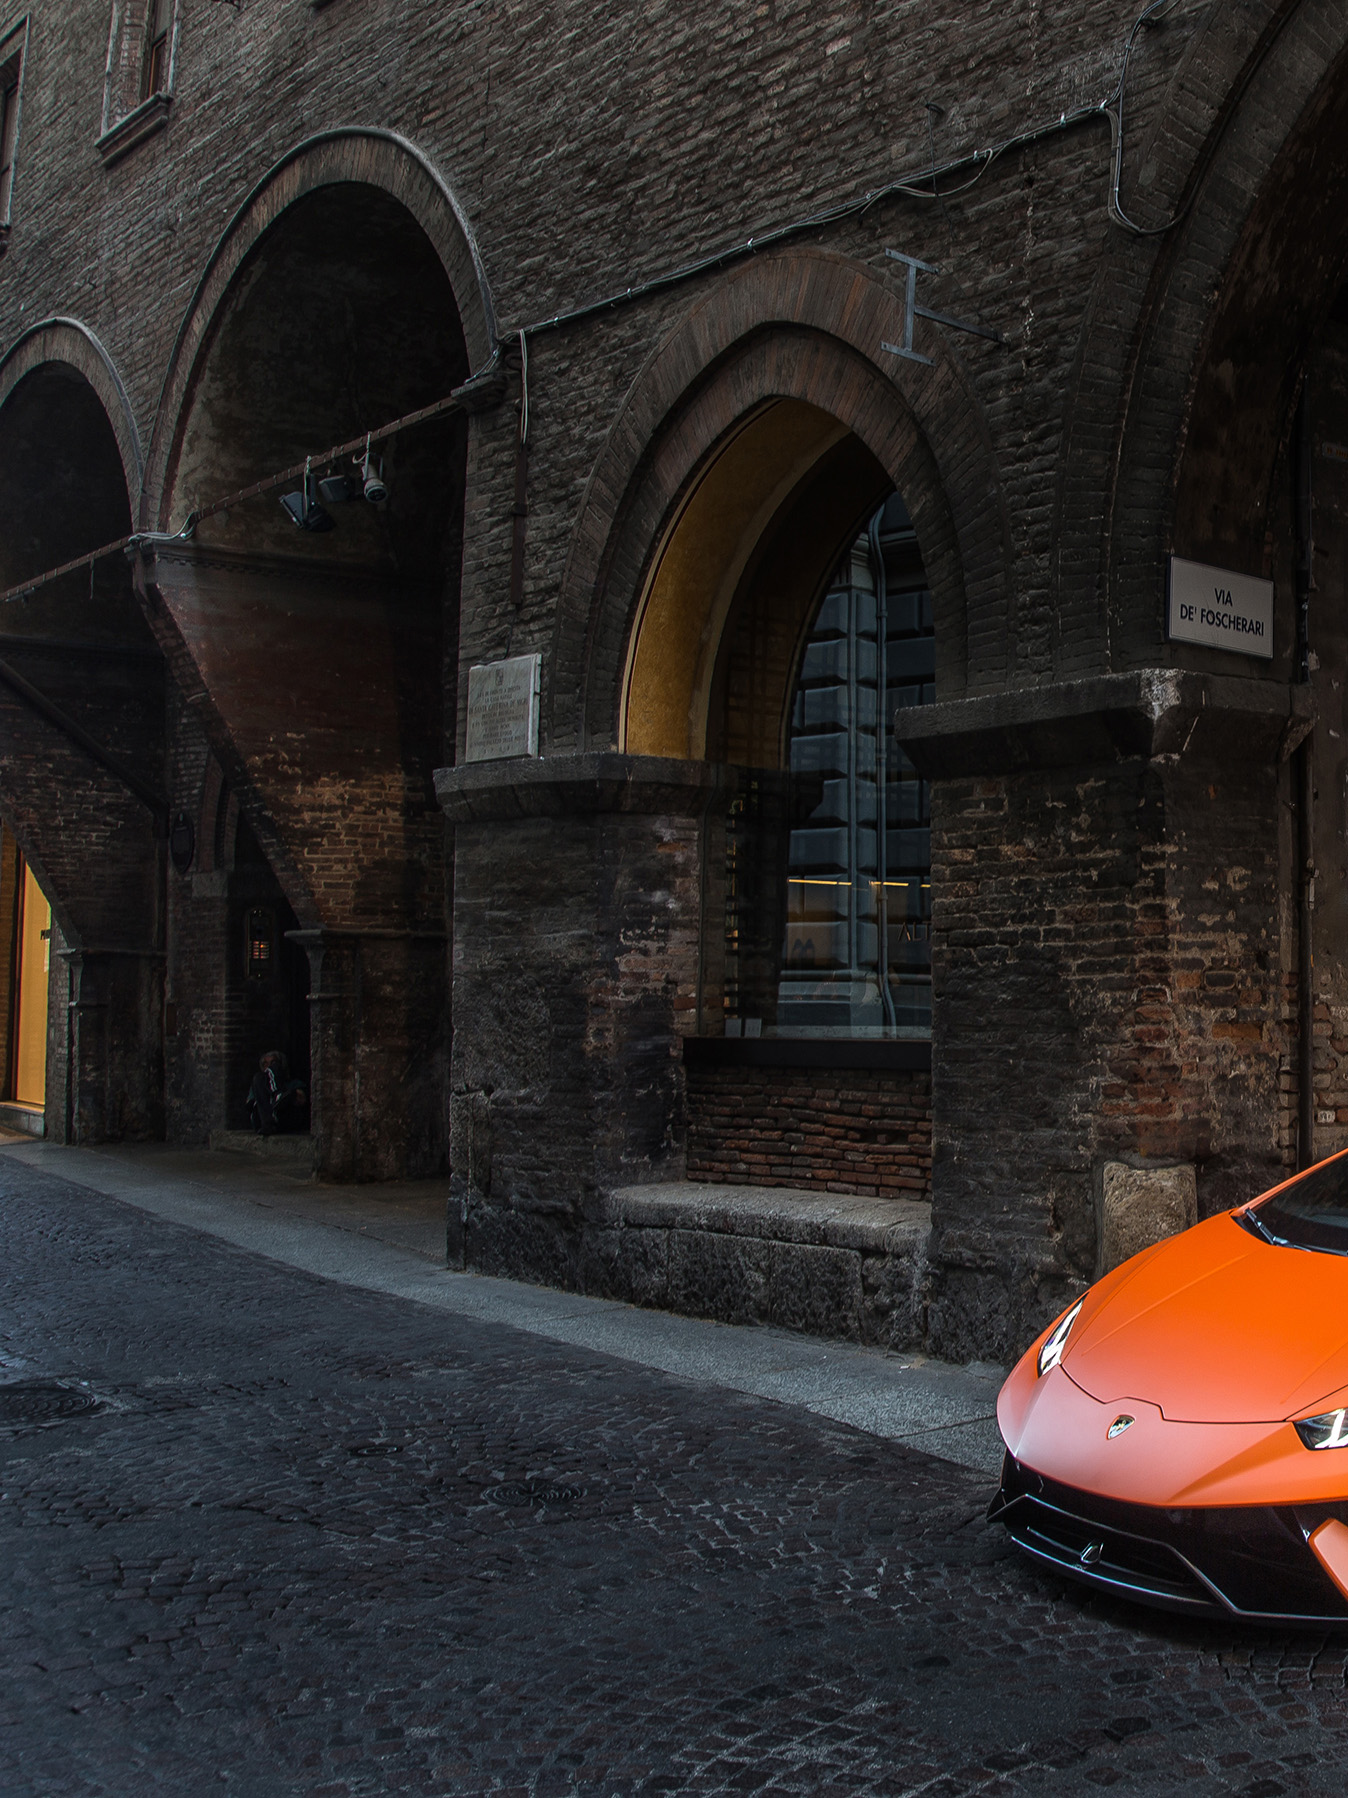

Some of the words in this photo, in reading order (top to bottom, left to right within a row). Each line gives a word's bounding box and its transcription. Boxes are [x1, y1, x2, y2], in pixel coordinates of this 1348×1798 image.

[1214, 588, 1233, 607] VIA
[1180, 604, 1197, 621] DE'
[1200, 608, 1264, 636] FOSCHERARI
